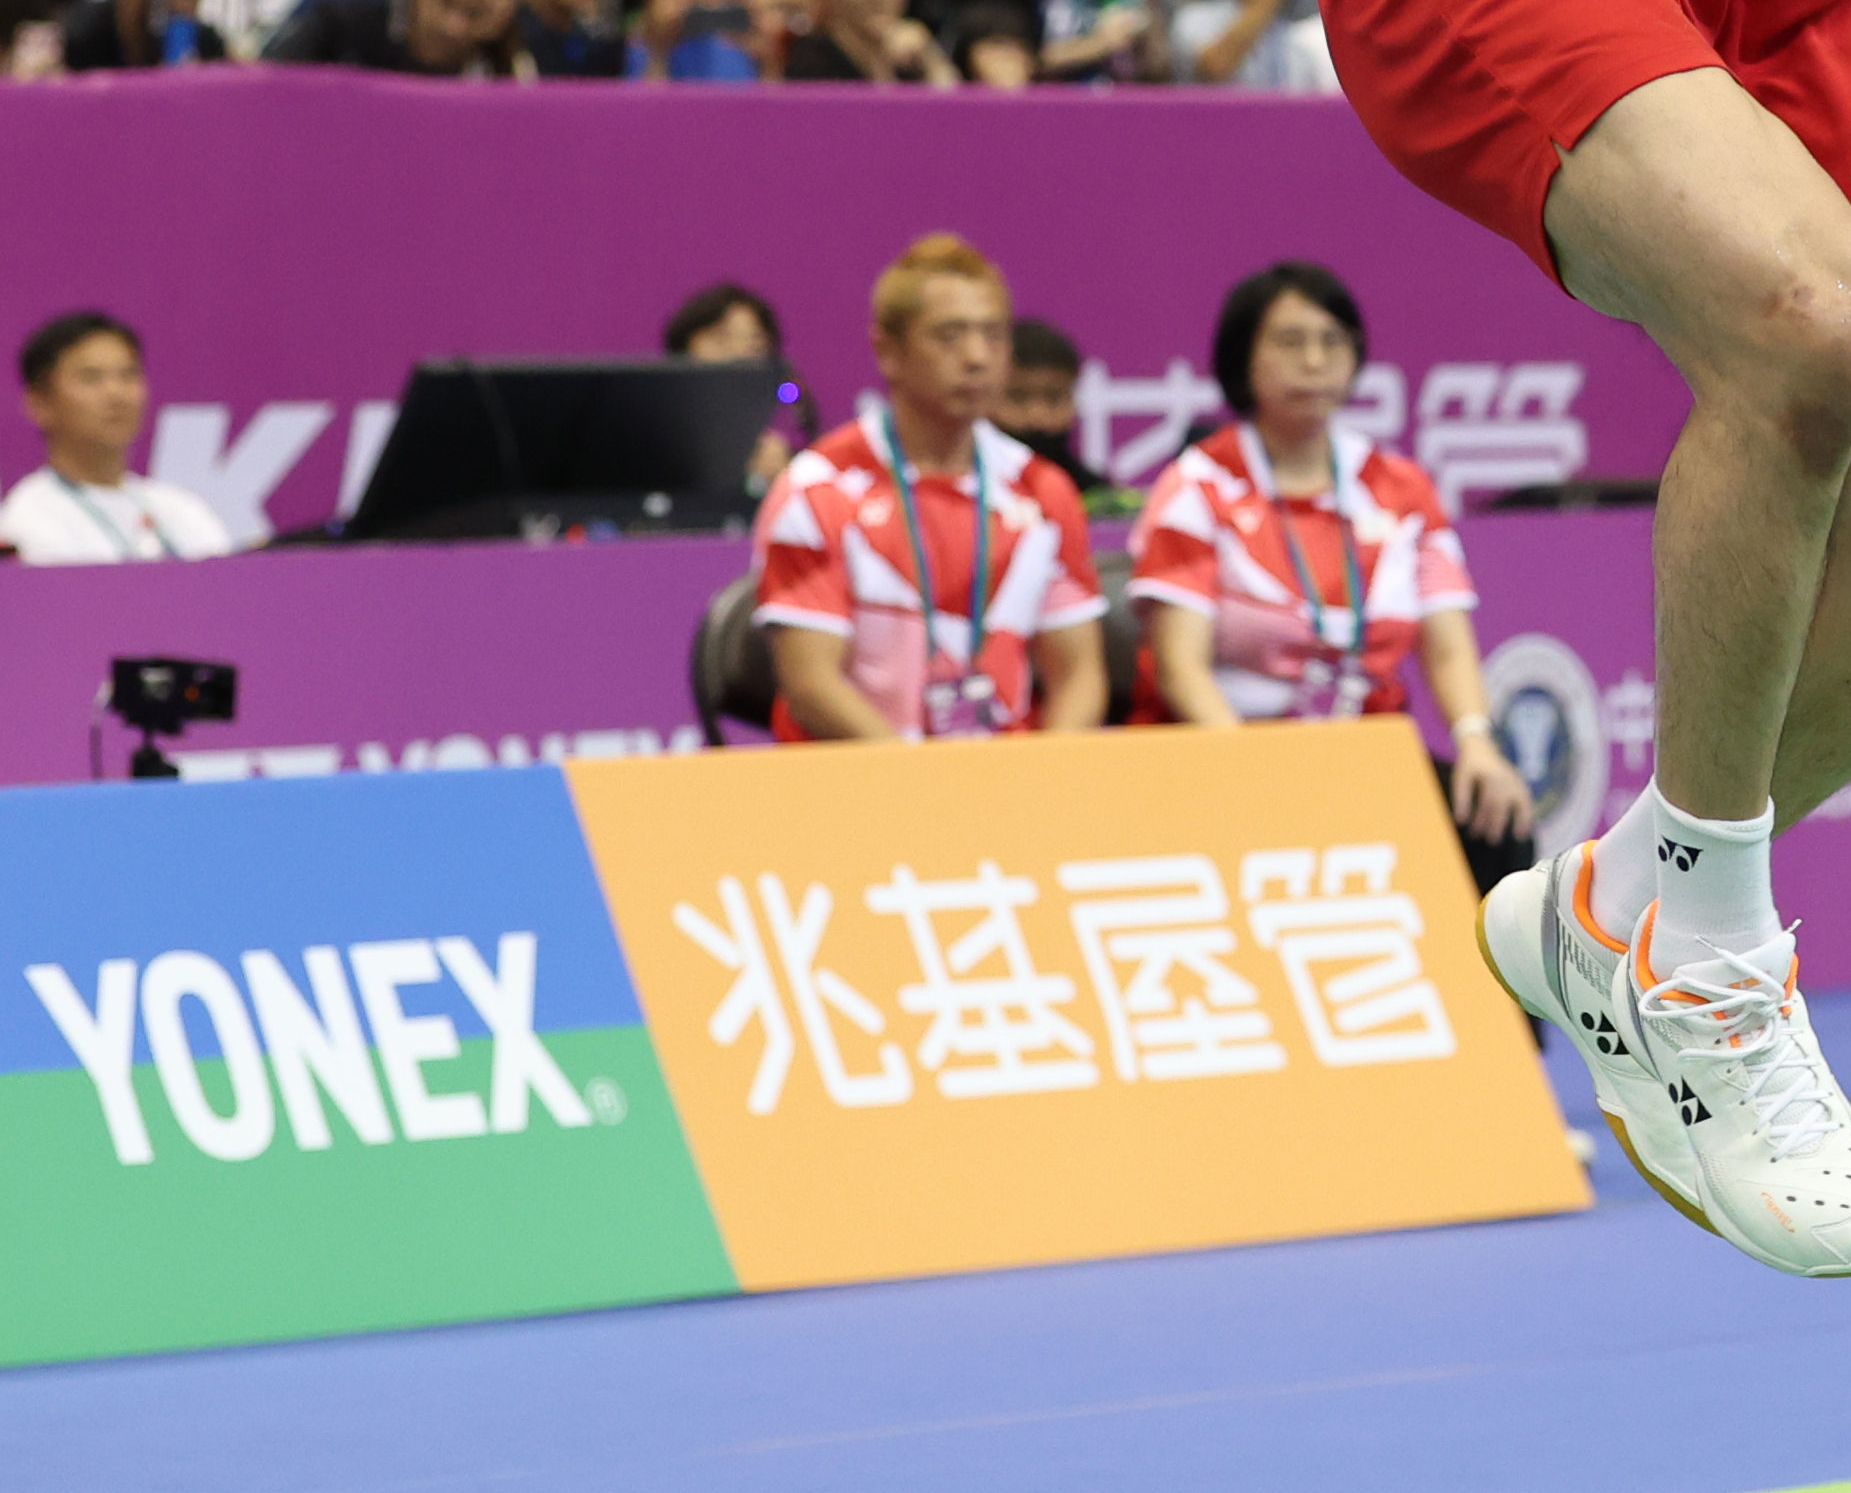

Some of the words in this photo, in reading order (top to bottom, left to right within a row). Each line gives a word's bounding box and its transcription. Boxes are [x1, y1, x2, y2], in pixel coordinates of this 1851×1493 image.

[24, 931, 594, 1165] YONEX
[673, 843, 1455, 1115] 兆基屋管
